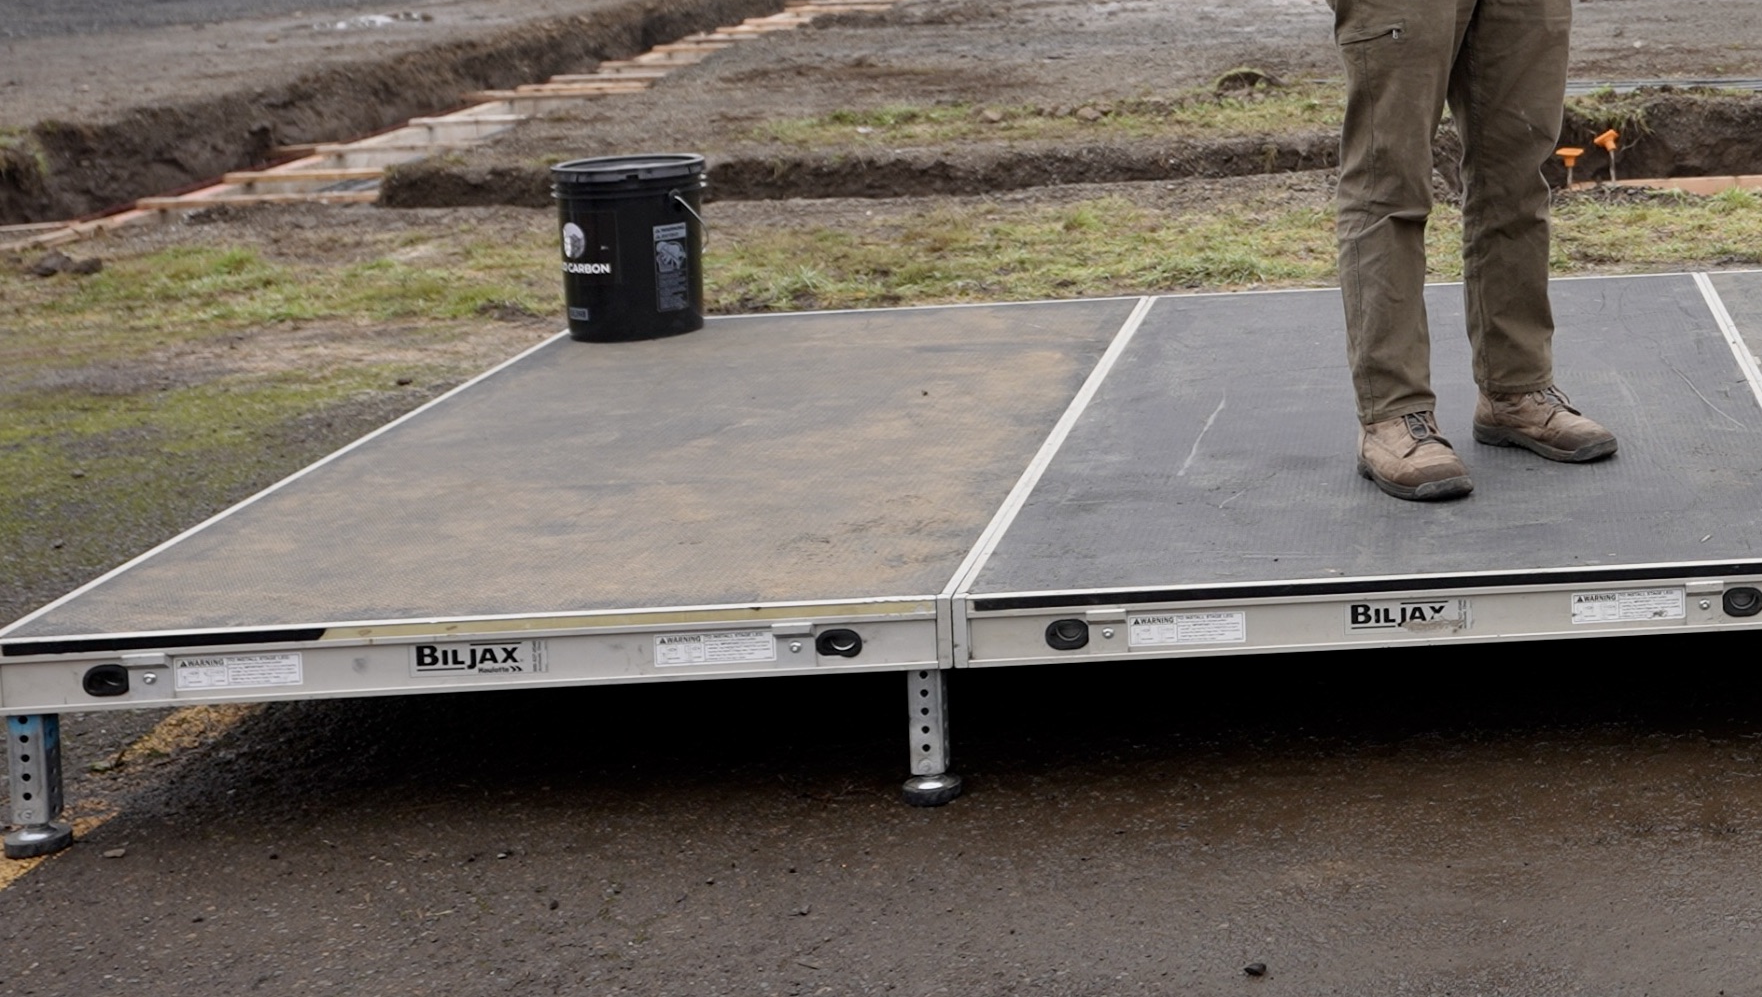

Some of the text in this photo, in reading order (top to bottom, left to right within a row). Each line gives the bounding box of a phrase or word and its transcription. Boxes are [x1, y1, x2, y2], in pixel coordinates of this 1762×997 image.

[568, 262, 611, 274] CARBON
[1584, 594, 1616, 602] WARNING
[1141, 616, 1174, 624] WARNING
[667, 635, 701, 643] WARNING
[416, 645, 519, 669] BILJAX
[188, 658, 224, 667] WARNING
